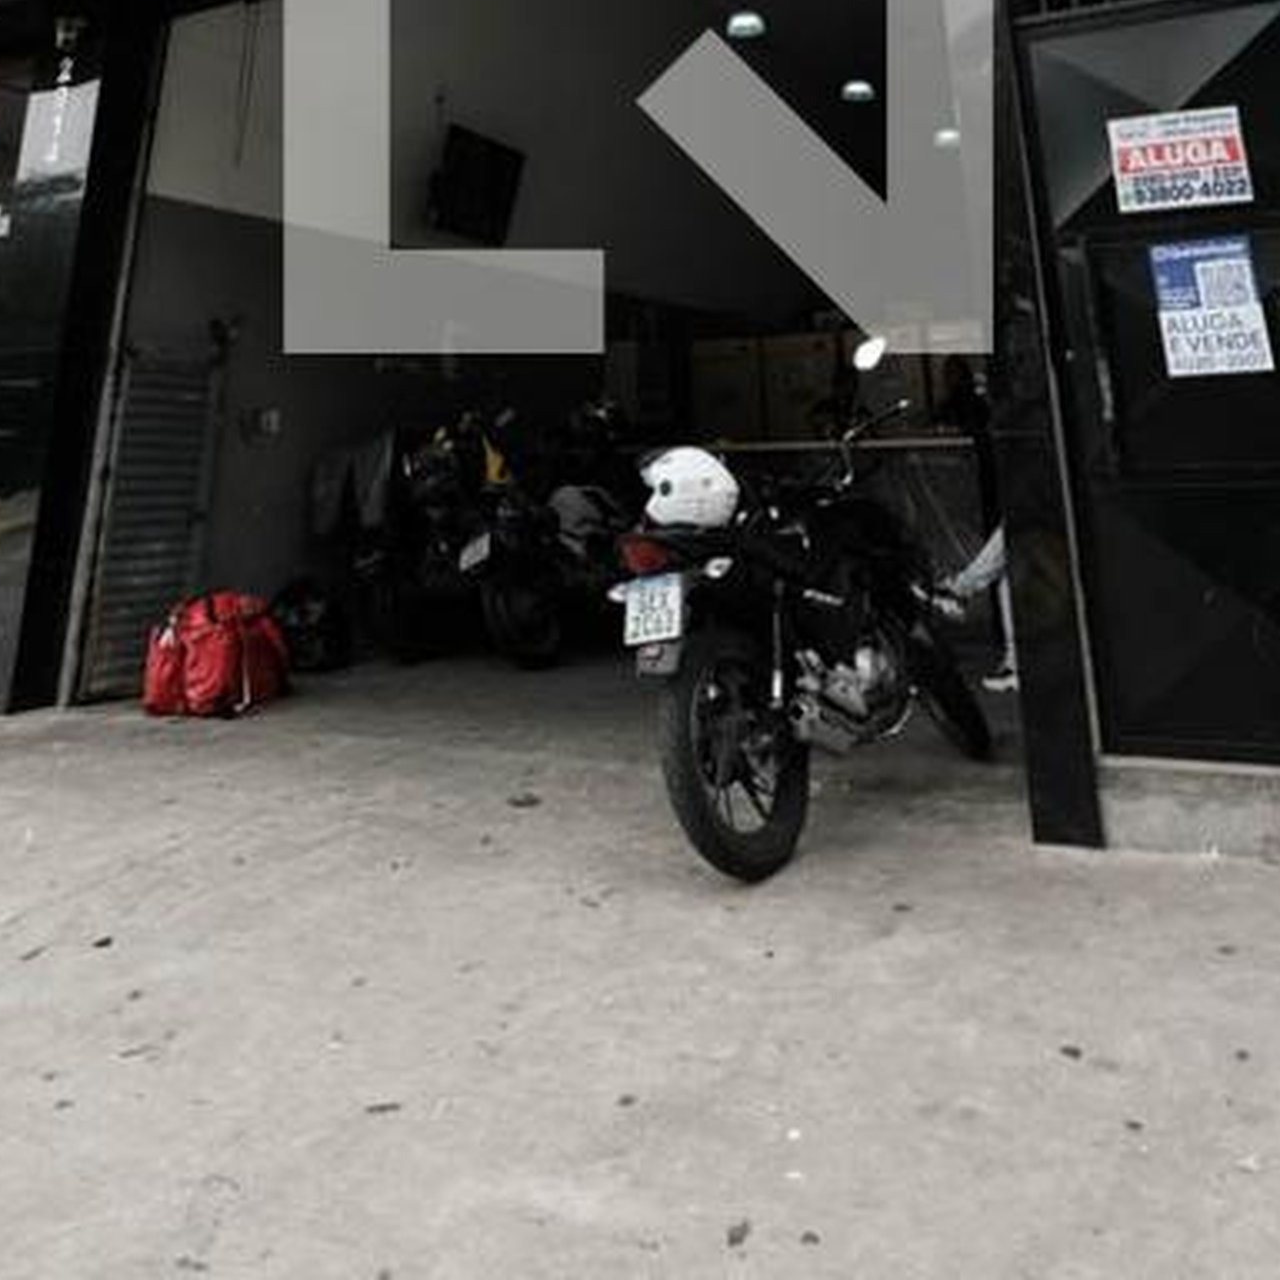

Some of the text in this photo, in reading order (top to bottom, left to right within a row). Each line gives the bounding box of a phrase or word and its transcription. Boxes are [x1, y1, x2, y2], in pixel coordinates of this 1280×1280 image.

[1127, 138, 1228, 169] ALUGA
[1167, 312, 1243, 334] ALUGA
[1185, 328, 1260, 353] VENDE
